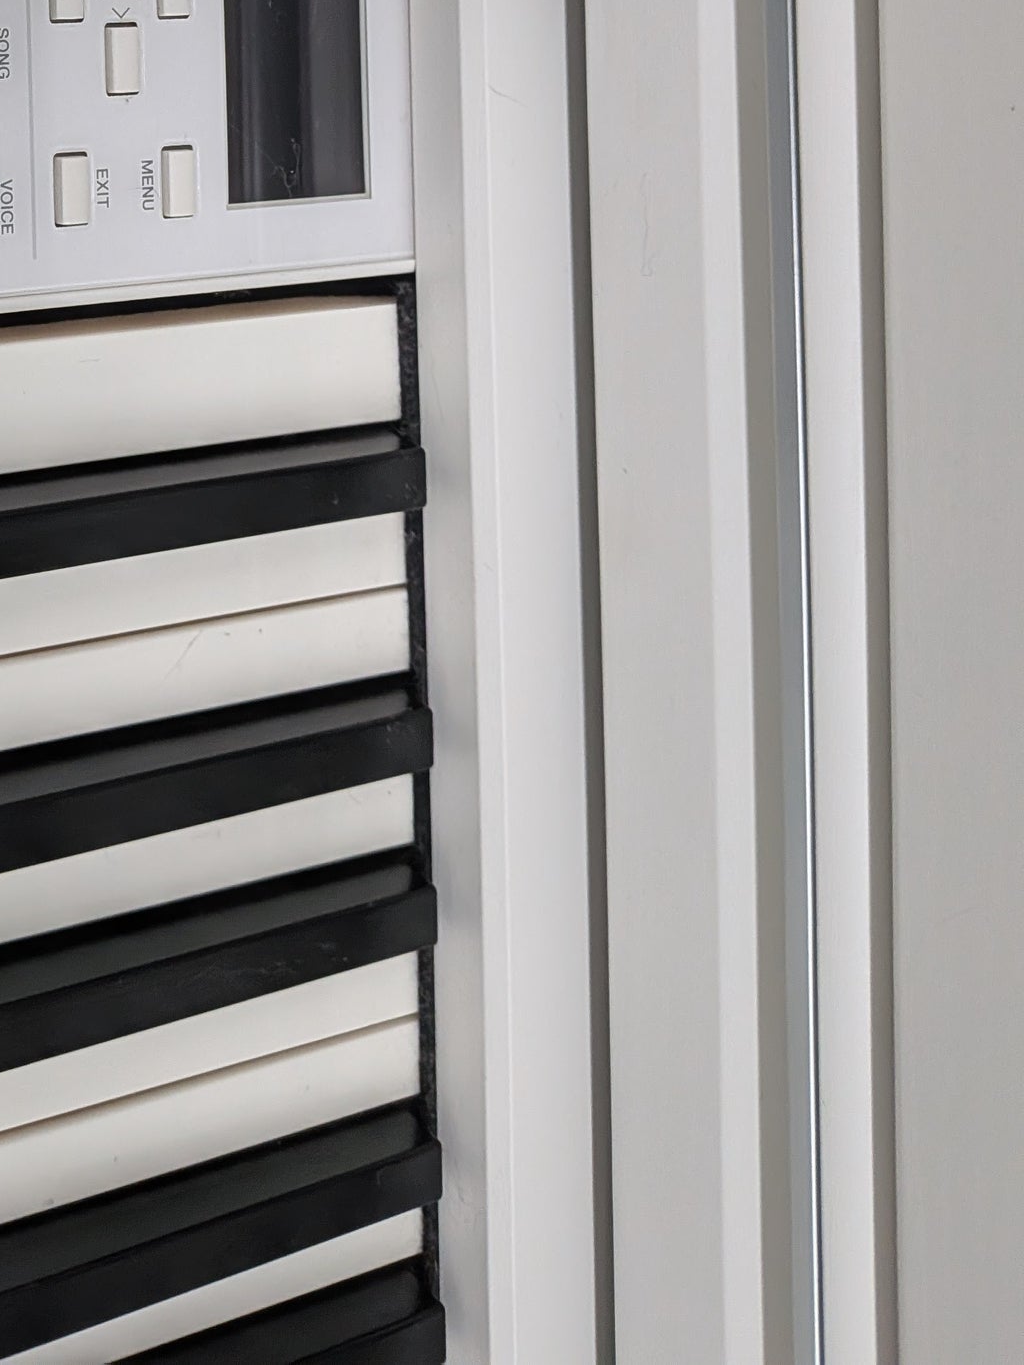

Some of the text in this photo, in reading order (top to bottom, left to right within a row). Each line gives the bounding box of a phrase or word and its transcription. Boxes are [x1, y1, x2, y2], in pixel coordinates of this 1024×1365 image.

[0, 179, 14, 235] VOICE
[95, 168, 110, 209] EXIT
[140, 160, 155, 211] MENU
